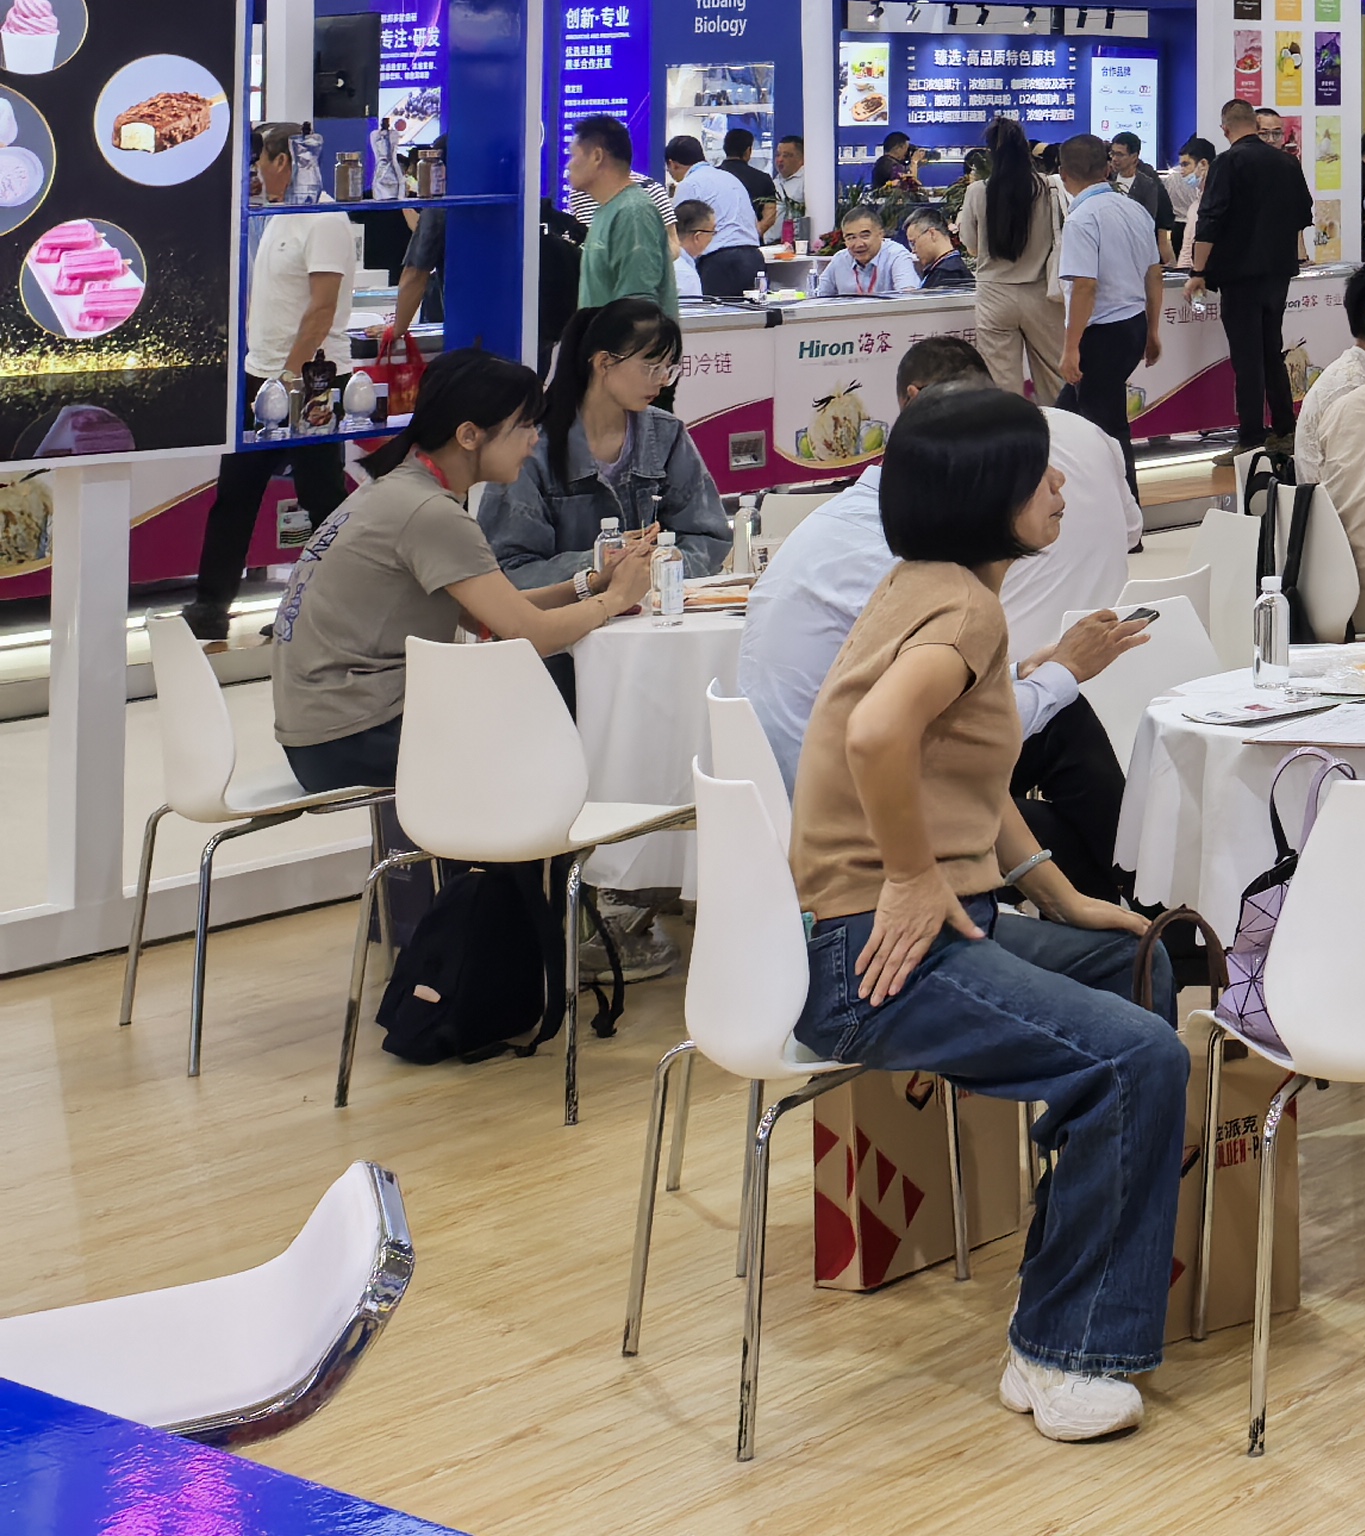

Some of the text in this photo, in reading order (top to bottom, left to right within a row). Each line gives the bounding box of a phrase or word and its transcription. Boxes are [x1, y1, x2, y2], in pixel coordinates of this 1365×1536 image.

[565, 6, 630, 29] 创新·专业
[694, 17, 747, 37] Biology
[380, 26, 441, 50] 专注·研发
[1101, 65, 1132, 77] 合作品牌
[799, 338, 854, 359] Hiron
[859, 330, 894, 354] 海容
